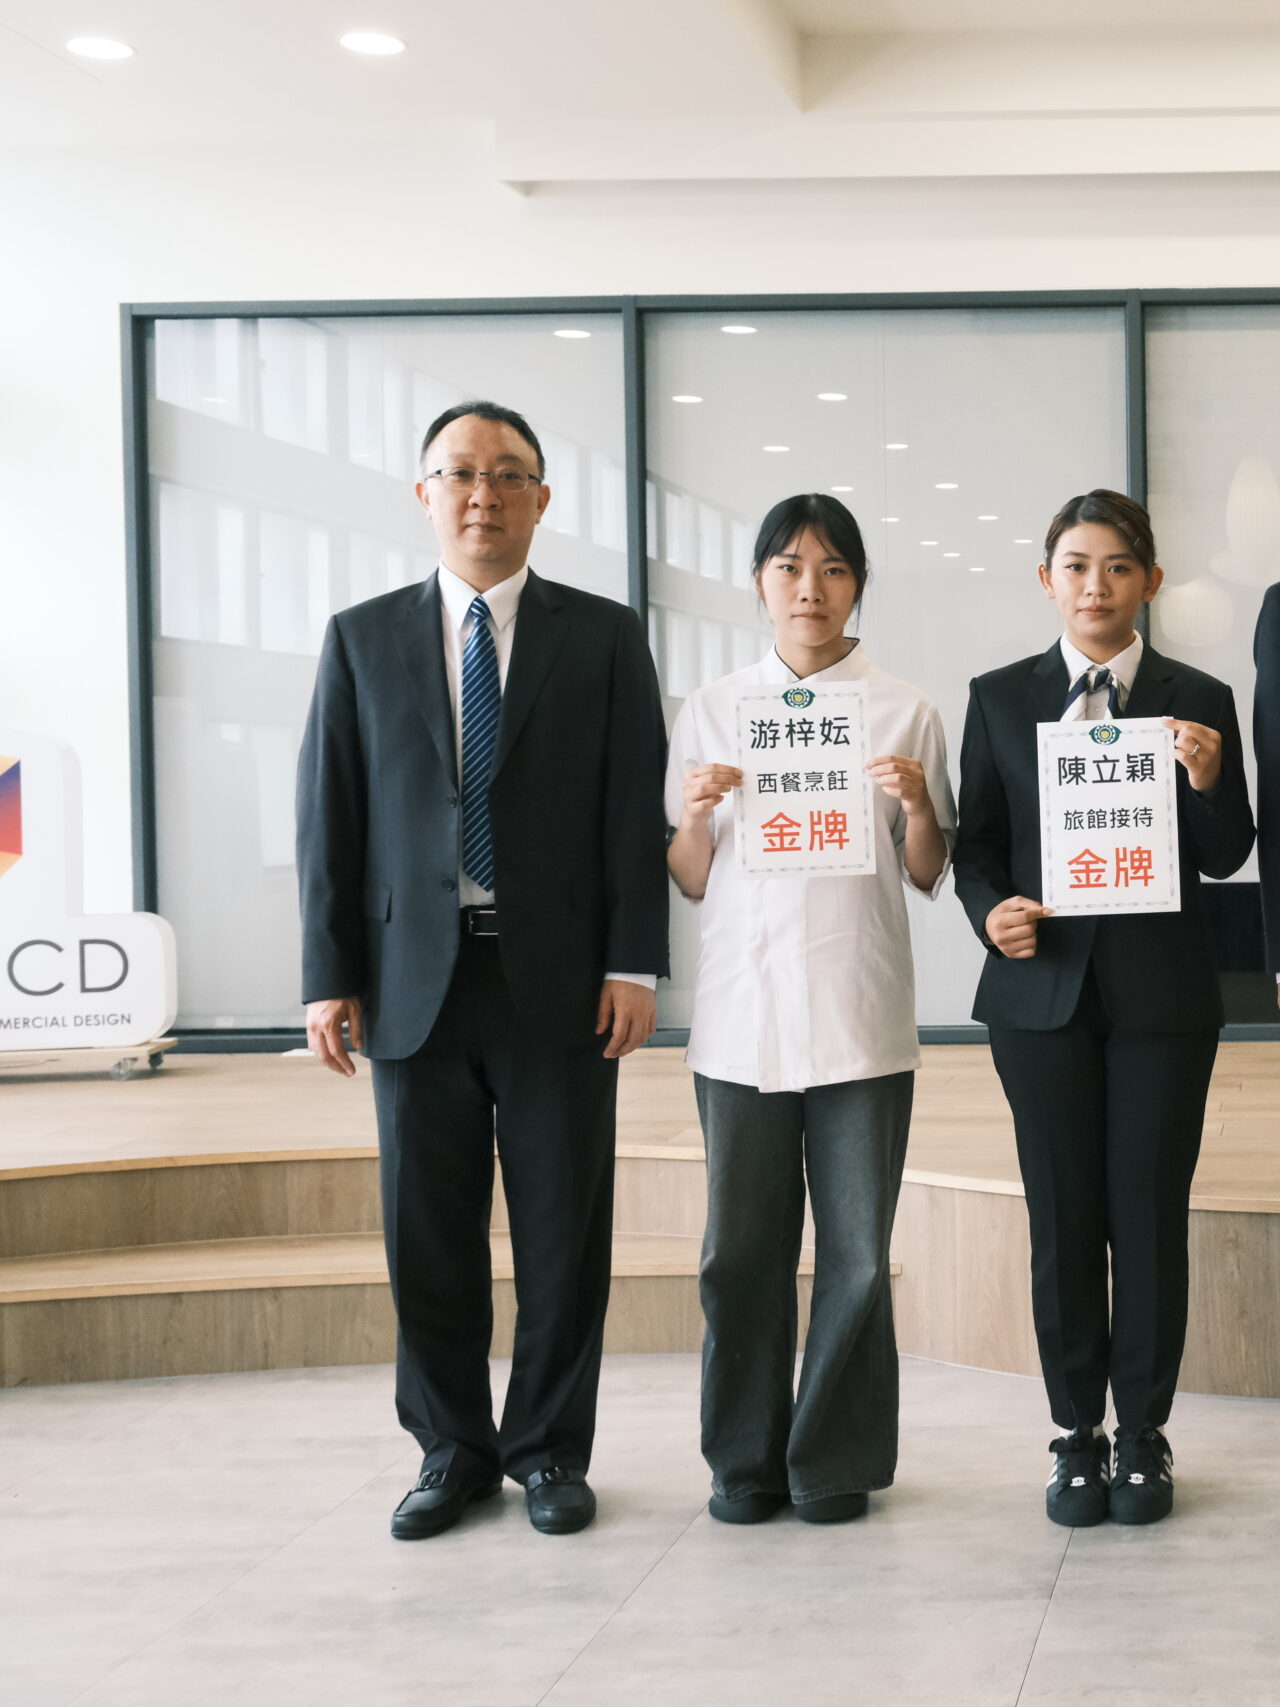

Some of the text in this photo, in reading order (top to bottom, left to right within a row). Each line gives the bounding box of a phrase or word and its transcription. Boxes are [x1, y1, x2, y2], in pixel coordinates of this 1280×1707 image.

[750, 716, 851, 750] 游梓妘
[757, 770, 849, 795] 西餐烹飪
[1057, 752, 1156, 787] 陳立穎
[761, 809, 850, 853] 金牌
[1063, 805, 1154, 831] 旅館接待
[1067, 846, 1155, 889] 金牌
[7, 938, 129, 997] CD
[73, 1013, 131, 1027] DESIGN
